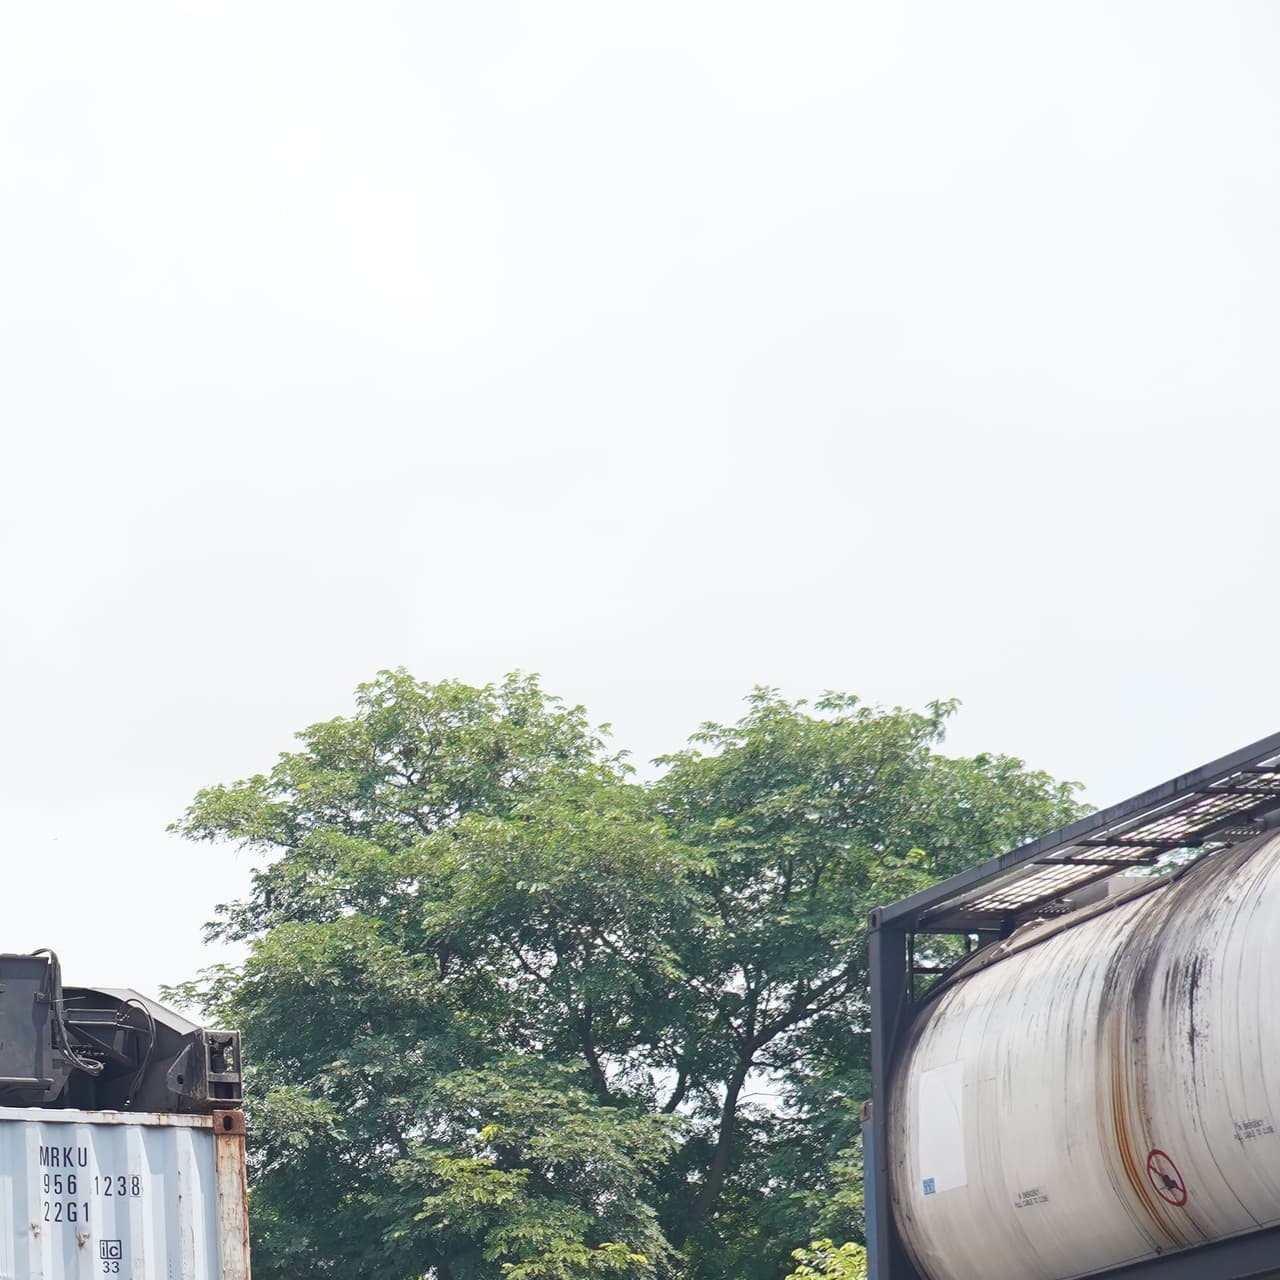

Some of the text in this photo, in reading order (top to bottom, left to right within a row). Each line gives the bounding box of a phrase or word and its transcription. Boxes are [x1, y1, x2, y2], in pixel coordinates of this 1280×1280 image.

[40, 1146, 88, 1168] MRKU
[43, 1174, 140, 1197] 956 1238
[44, 1201, 89, 1222] 22G1
[102, 1261, 120, 1274] 33
